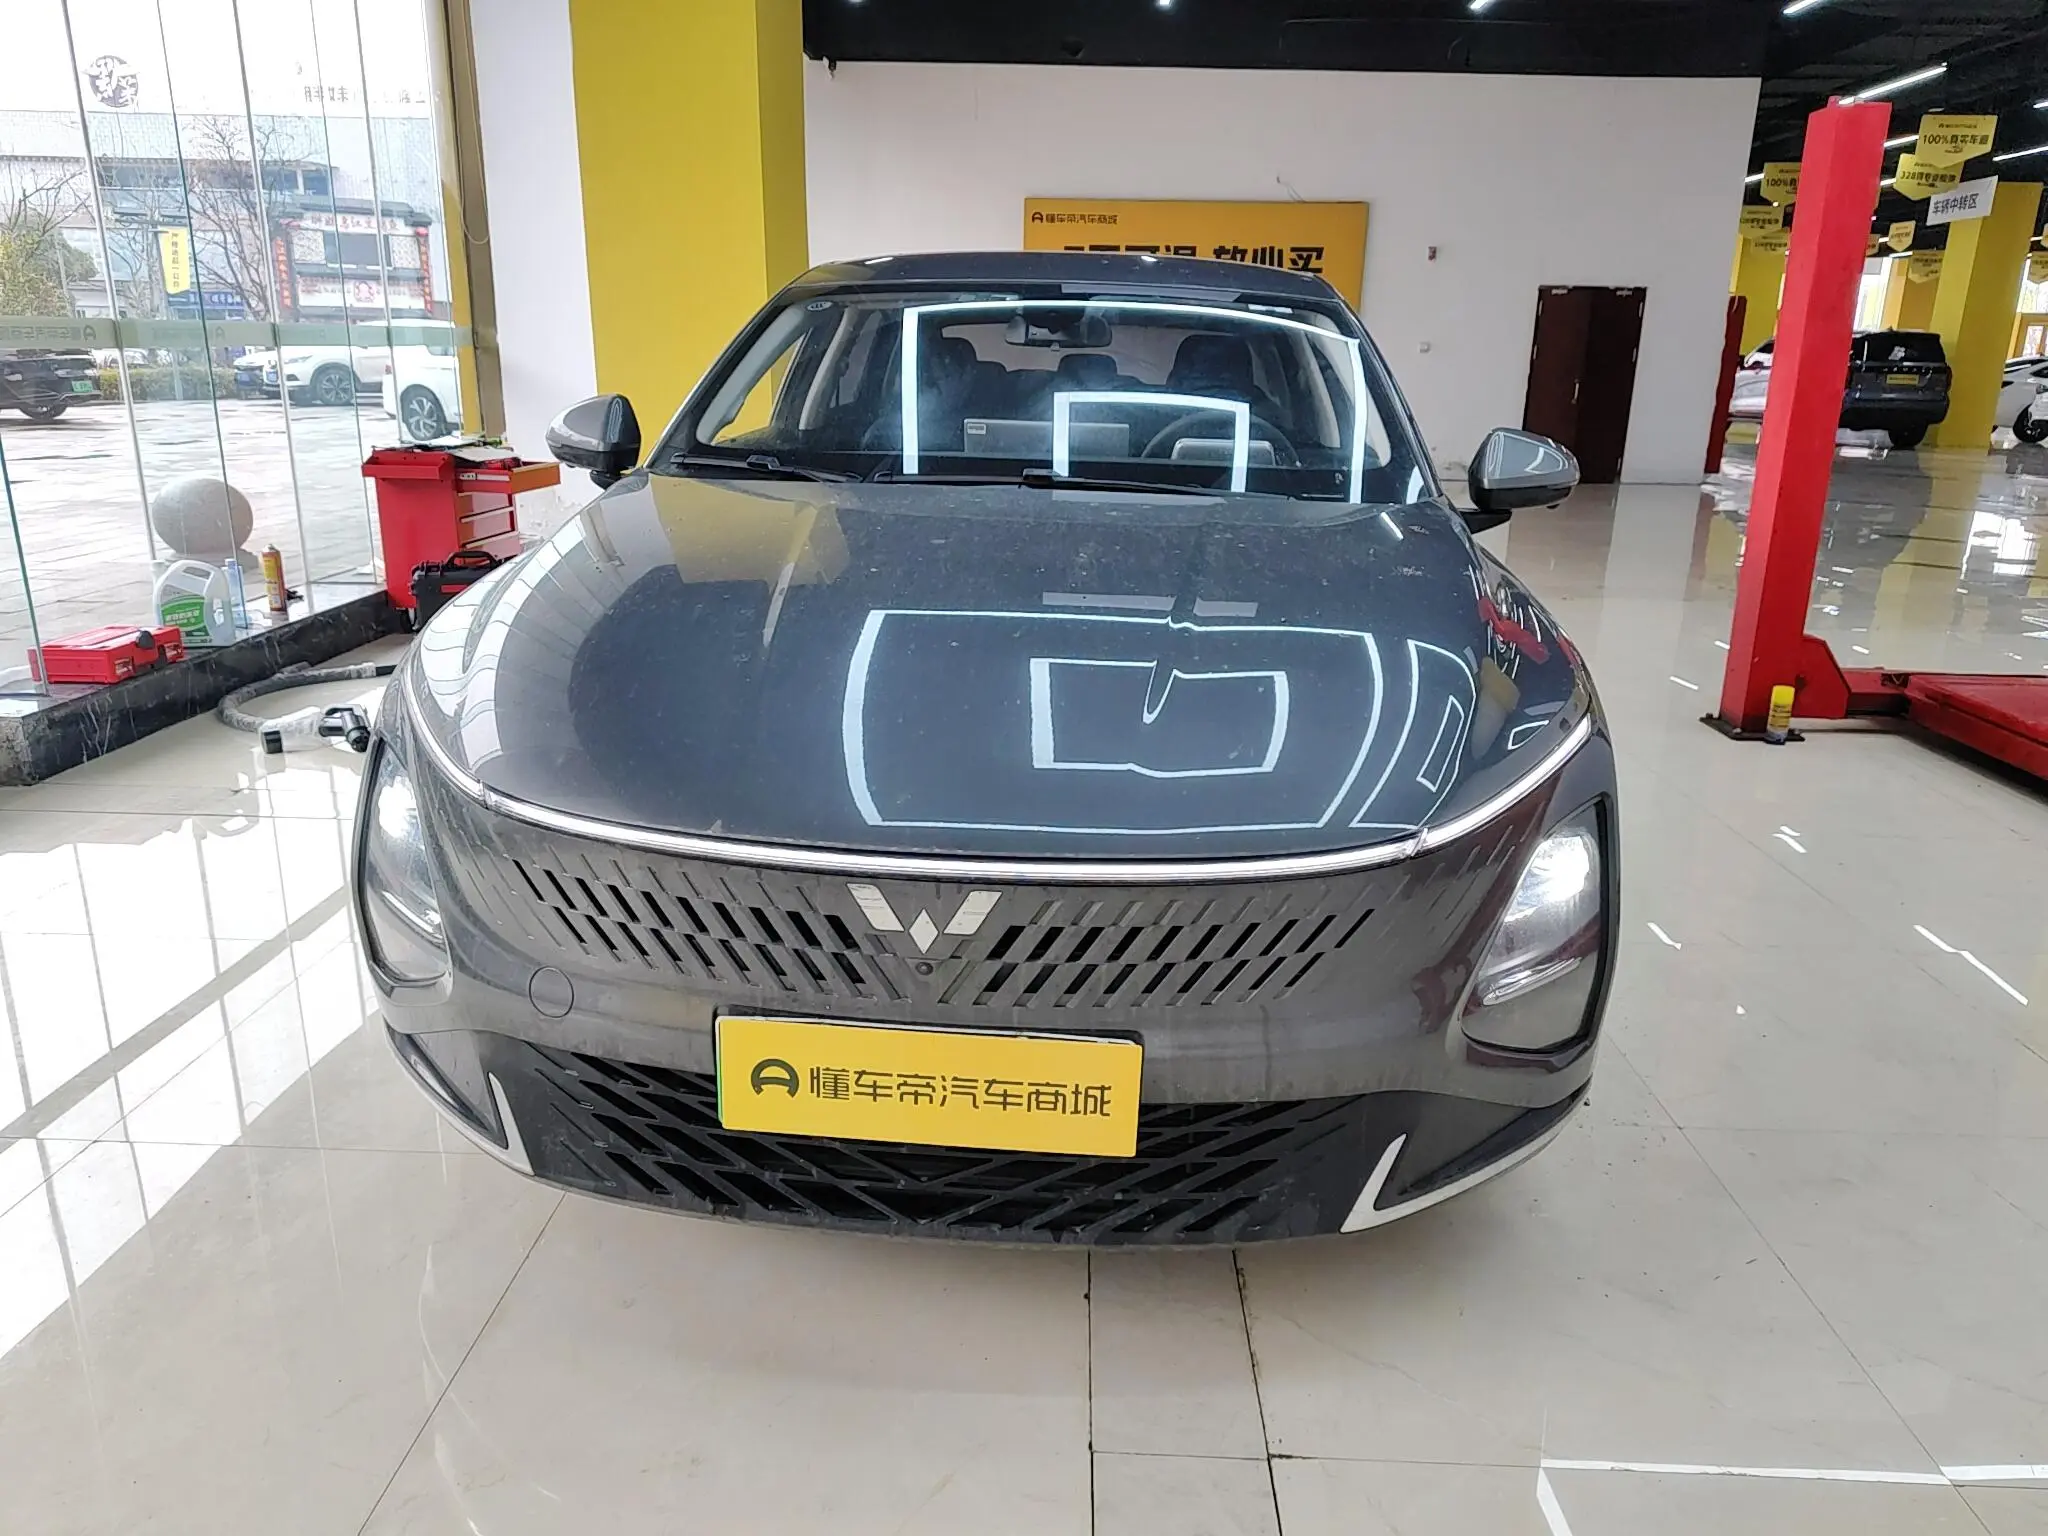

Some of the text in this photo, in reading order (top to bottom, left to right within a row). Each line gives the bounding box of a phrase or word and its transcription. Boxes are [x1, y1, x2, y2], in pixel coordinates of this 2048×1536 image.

[809, 1066, 1112, 1117] 懂车帝汽车商城
